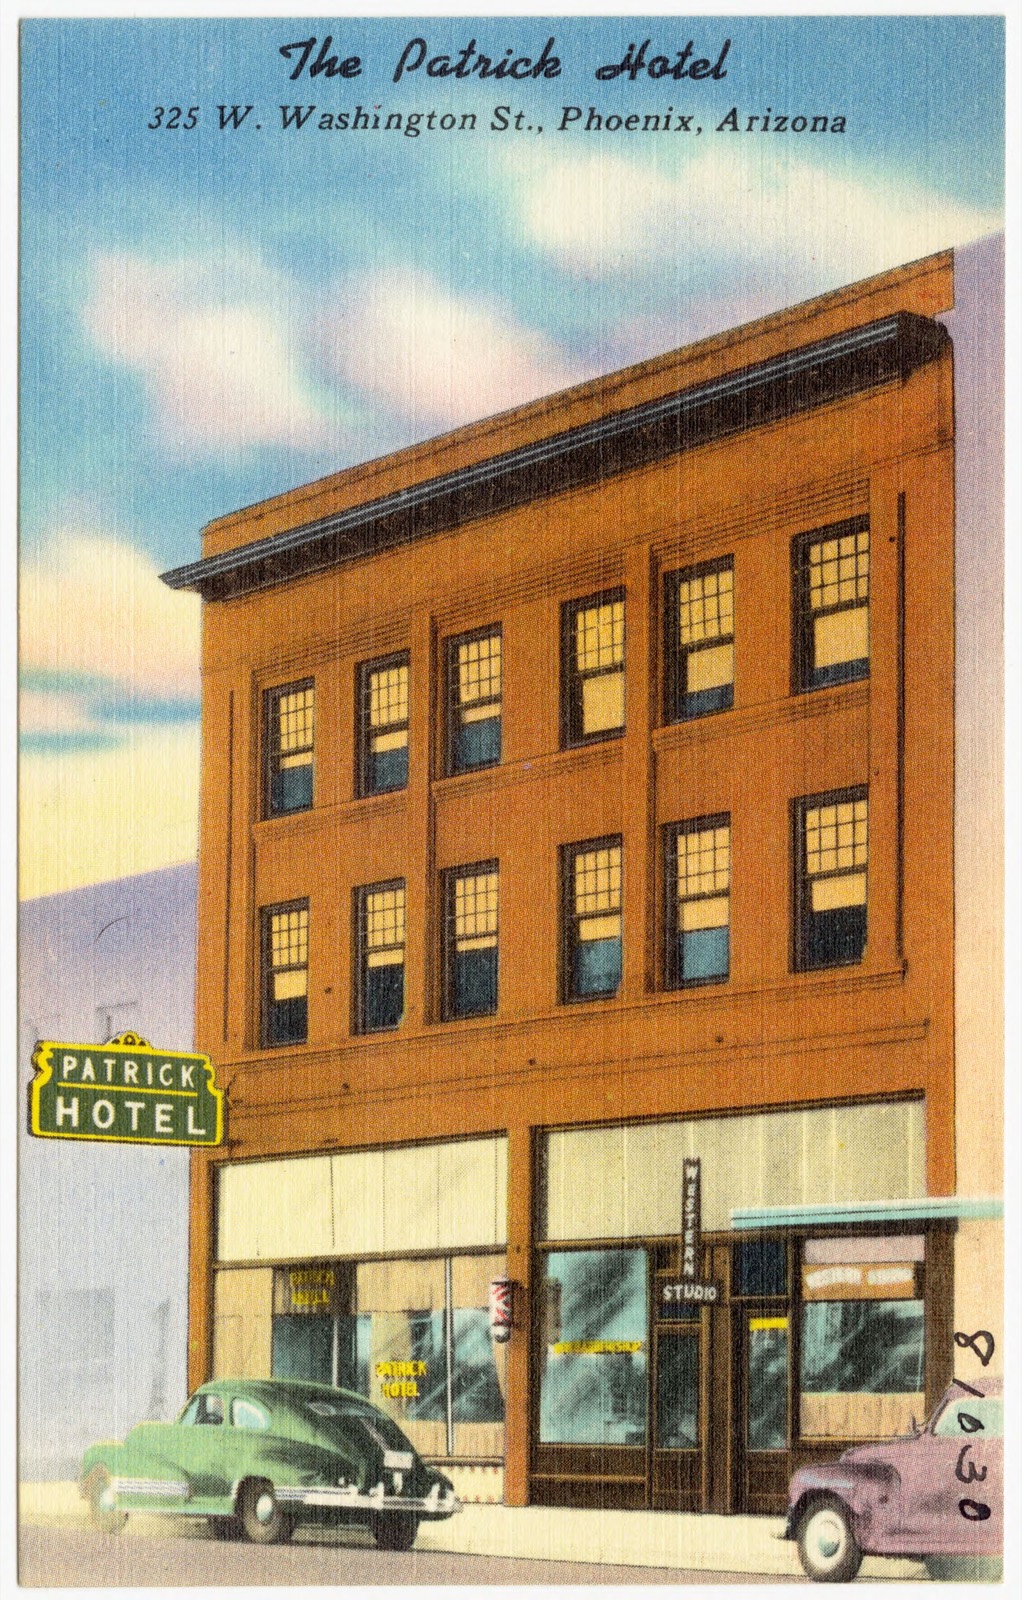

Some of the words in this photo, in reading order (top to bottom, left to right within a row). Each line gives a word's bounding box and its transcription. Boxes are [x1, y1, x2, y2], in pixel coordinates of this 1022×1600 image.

[62, 1055, 196, 1089] PATRICK
[55, 1095, 207, 1136] HOTEL
[683, 1164, 699, 1277] WESTERN
[662, 1284, 718, 1302] STUDIO
